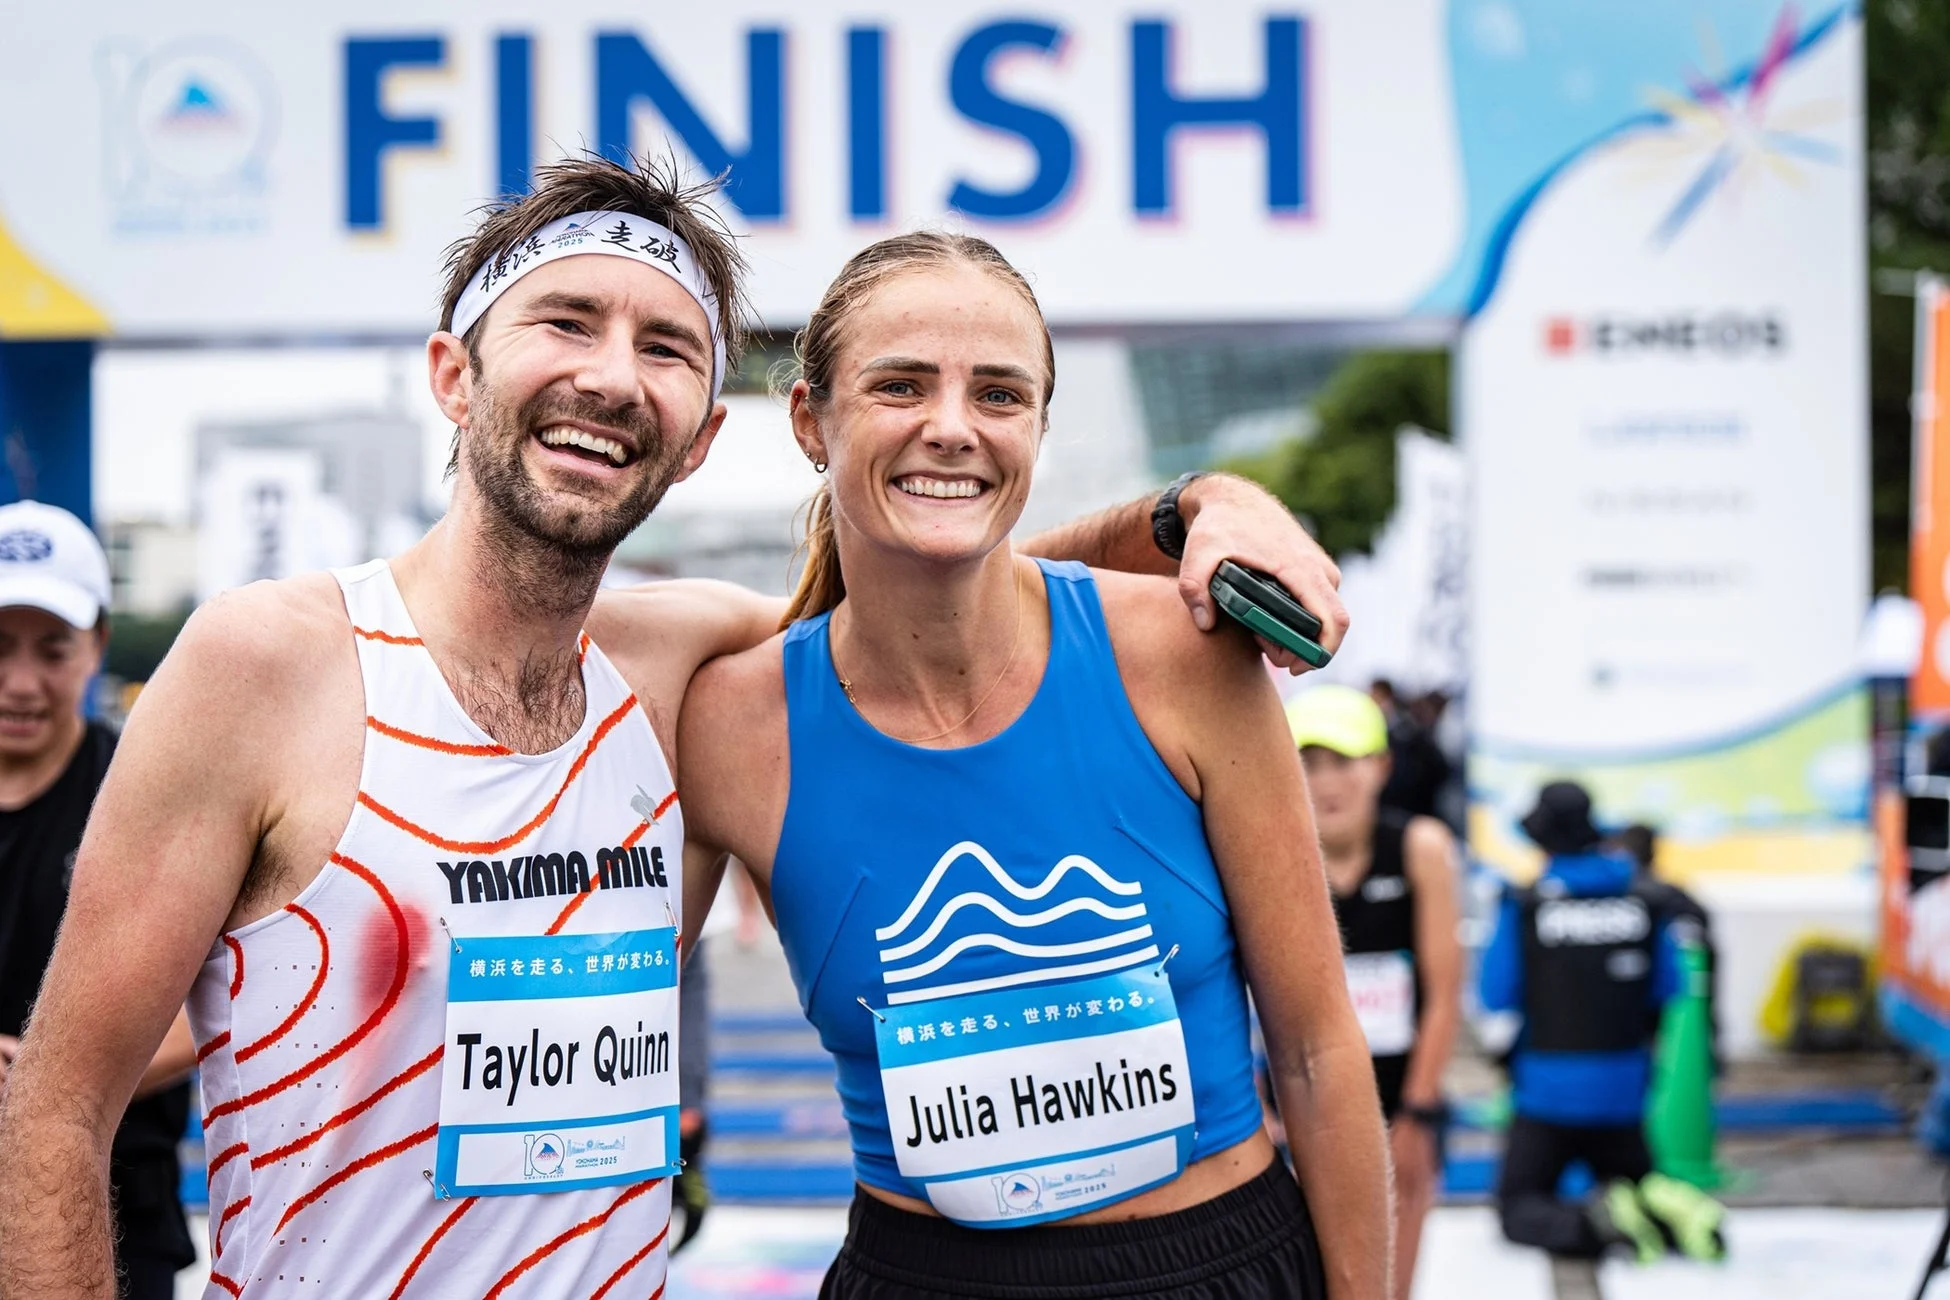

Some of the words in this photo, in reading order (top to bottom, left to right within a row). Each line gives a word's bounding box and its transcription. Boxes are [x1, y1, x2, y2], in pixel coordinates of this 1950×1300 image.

[343, 16, 1314, 232] FINISH
[557, 238, 584, 249] 2025
[600, 219, 683, 275] 走破
[436, 850, 592, 905] YAKIMA
[595, 846, 669, 891] MILE
[469, 949, 671, 978] 横浜を走る、世界が変わる。
[896, 990, 1156, 1046] 横浜を走る、世界が変わる。
[456, 1028, 580, 1107] Taylor
[593, 1020, 670, 1087] Quinn
[906, 1084, 999, 1148] Julia
[1010, 1058, 1178, 1129] Hawkins
[599, 1156, 618, 1166] 2025
